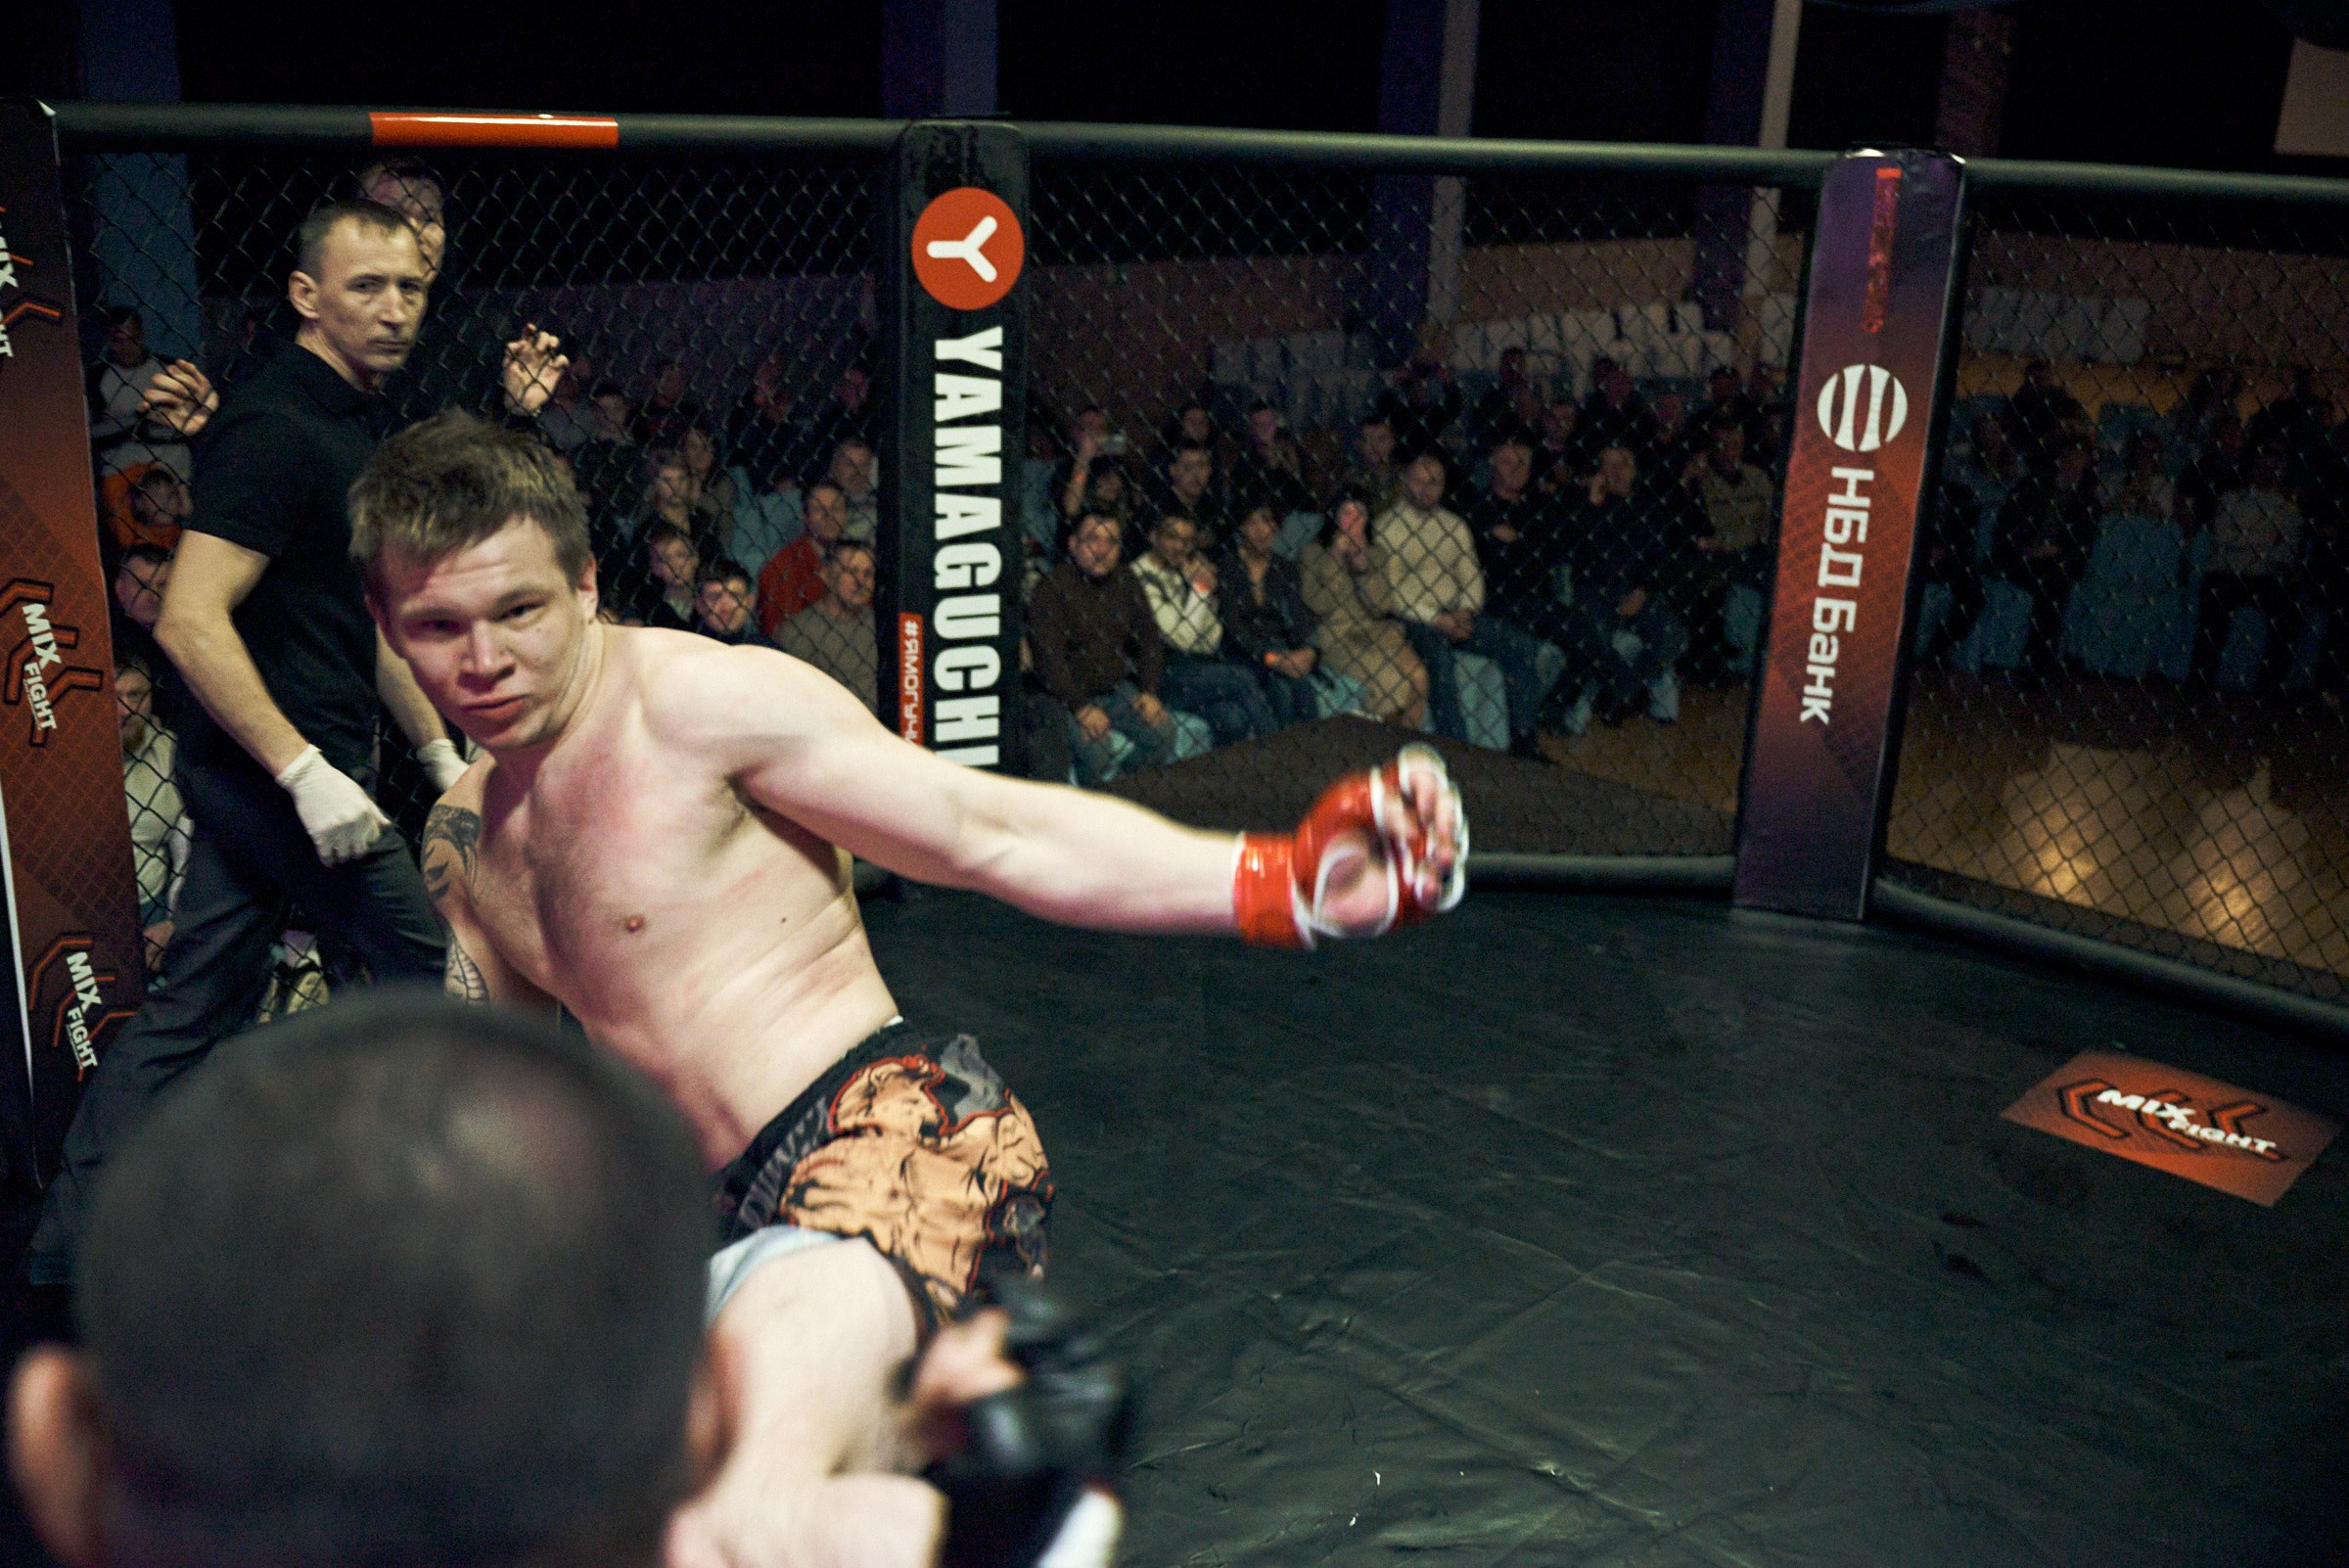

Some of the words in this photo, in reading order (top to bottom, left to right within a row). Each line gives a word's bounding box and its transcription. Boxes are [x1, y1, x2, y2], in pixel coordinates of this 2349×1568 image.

[927, 215, 997, 283] Y
[934, 326, 1002, 766] YAMAGUCHI
[1818, 467, 1874, 587] НБД
[23, 603, 62, 670] MIX
[1799, 596, 1858, 725] Банк
[24, 662, 57, 730] FIGHT
[66, 951, 102, 1013] MIX
[68, 1006, 98, 1068] FIGHT
[2096, 1088, 2196, 1124] MIX
[2168, 1118, 2277, 1154] FIGHT
